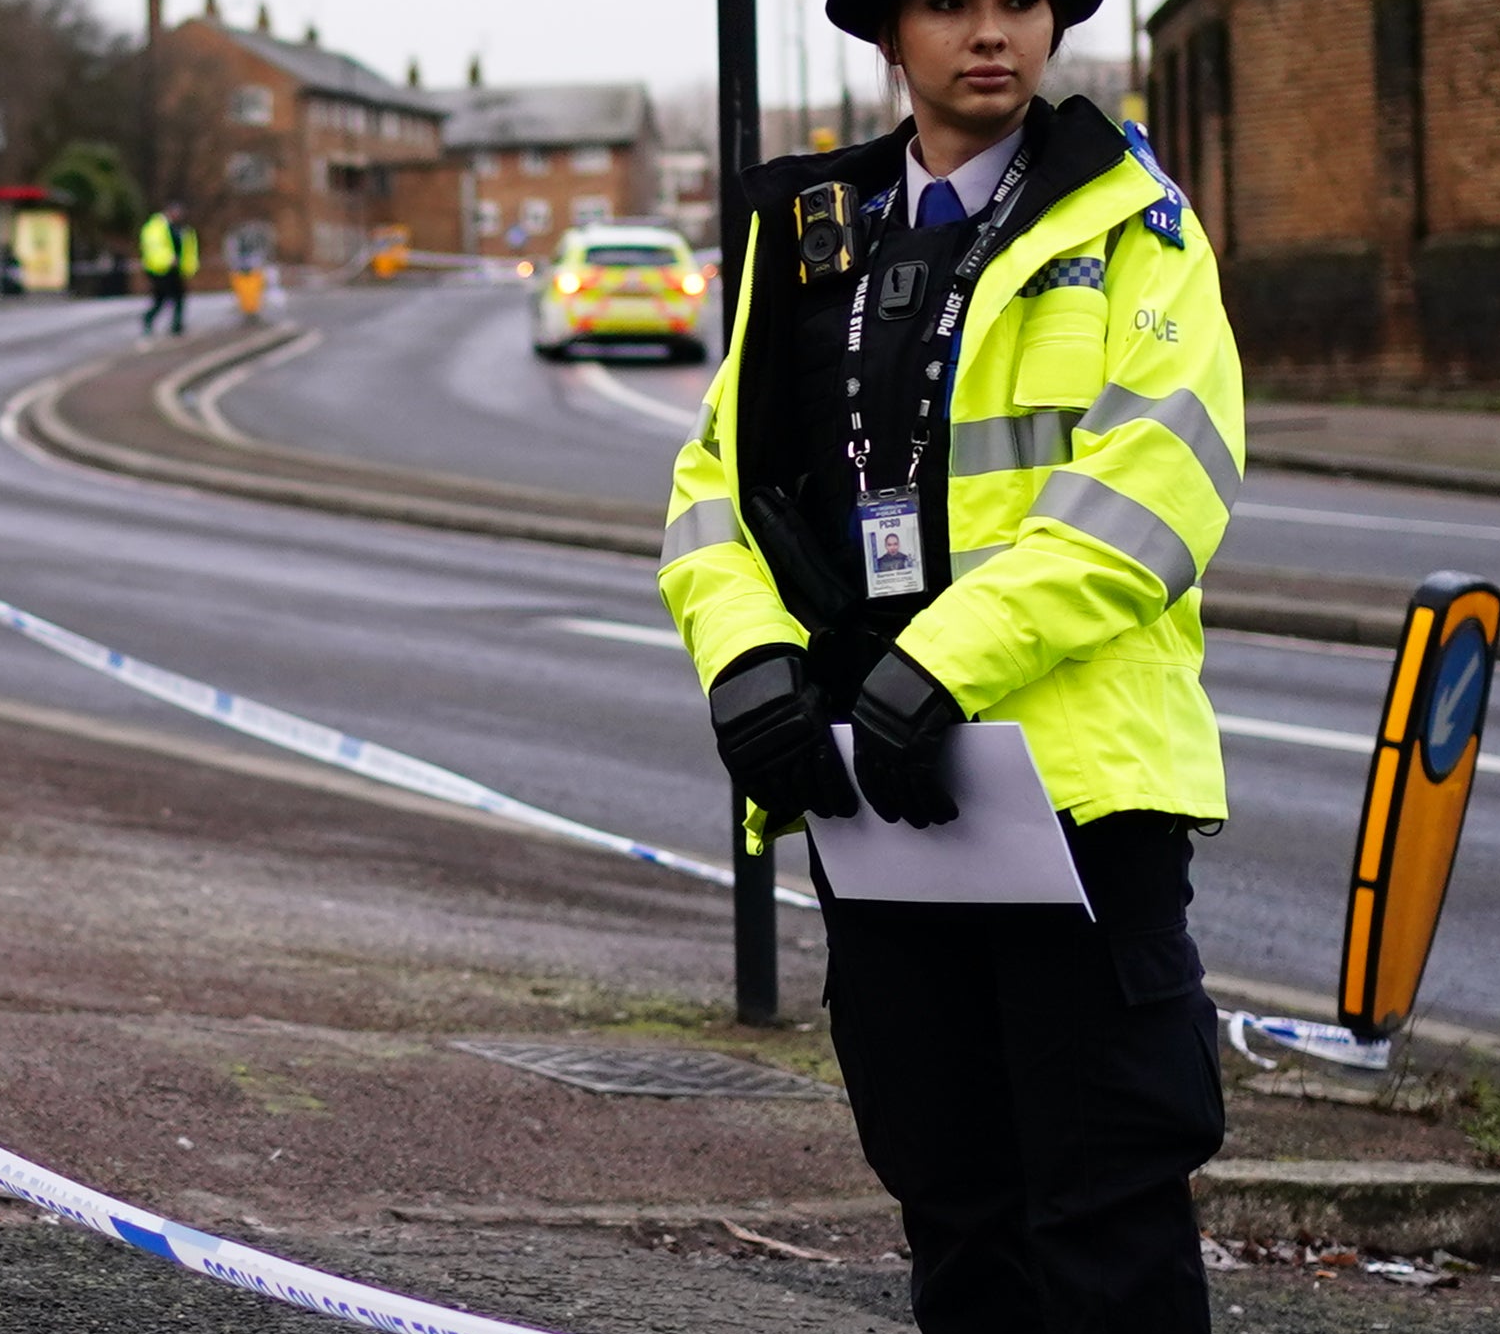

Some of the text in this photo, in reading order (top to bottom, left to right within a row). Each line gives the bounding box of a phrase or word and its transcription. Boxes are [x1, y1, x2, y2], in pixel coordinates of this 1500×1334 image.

[993, 167, 1022, 203] POLICE
[847, 273, 870, 353] POLICE STAFF
[936, 292, 965, 337] POLICE
